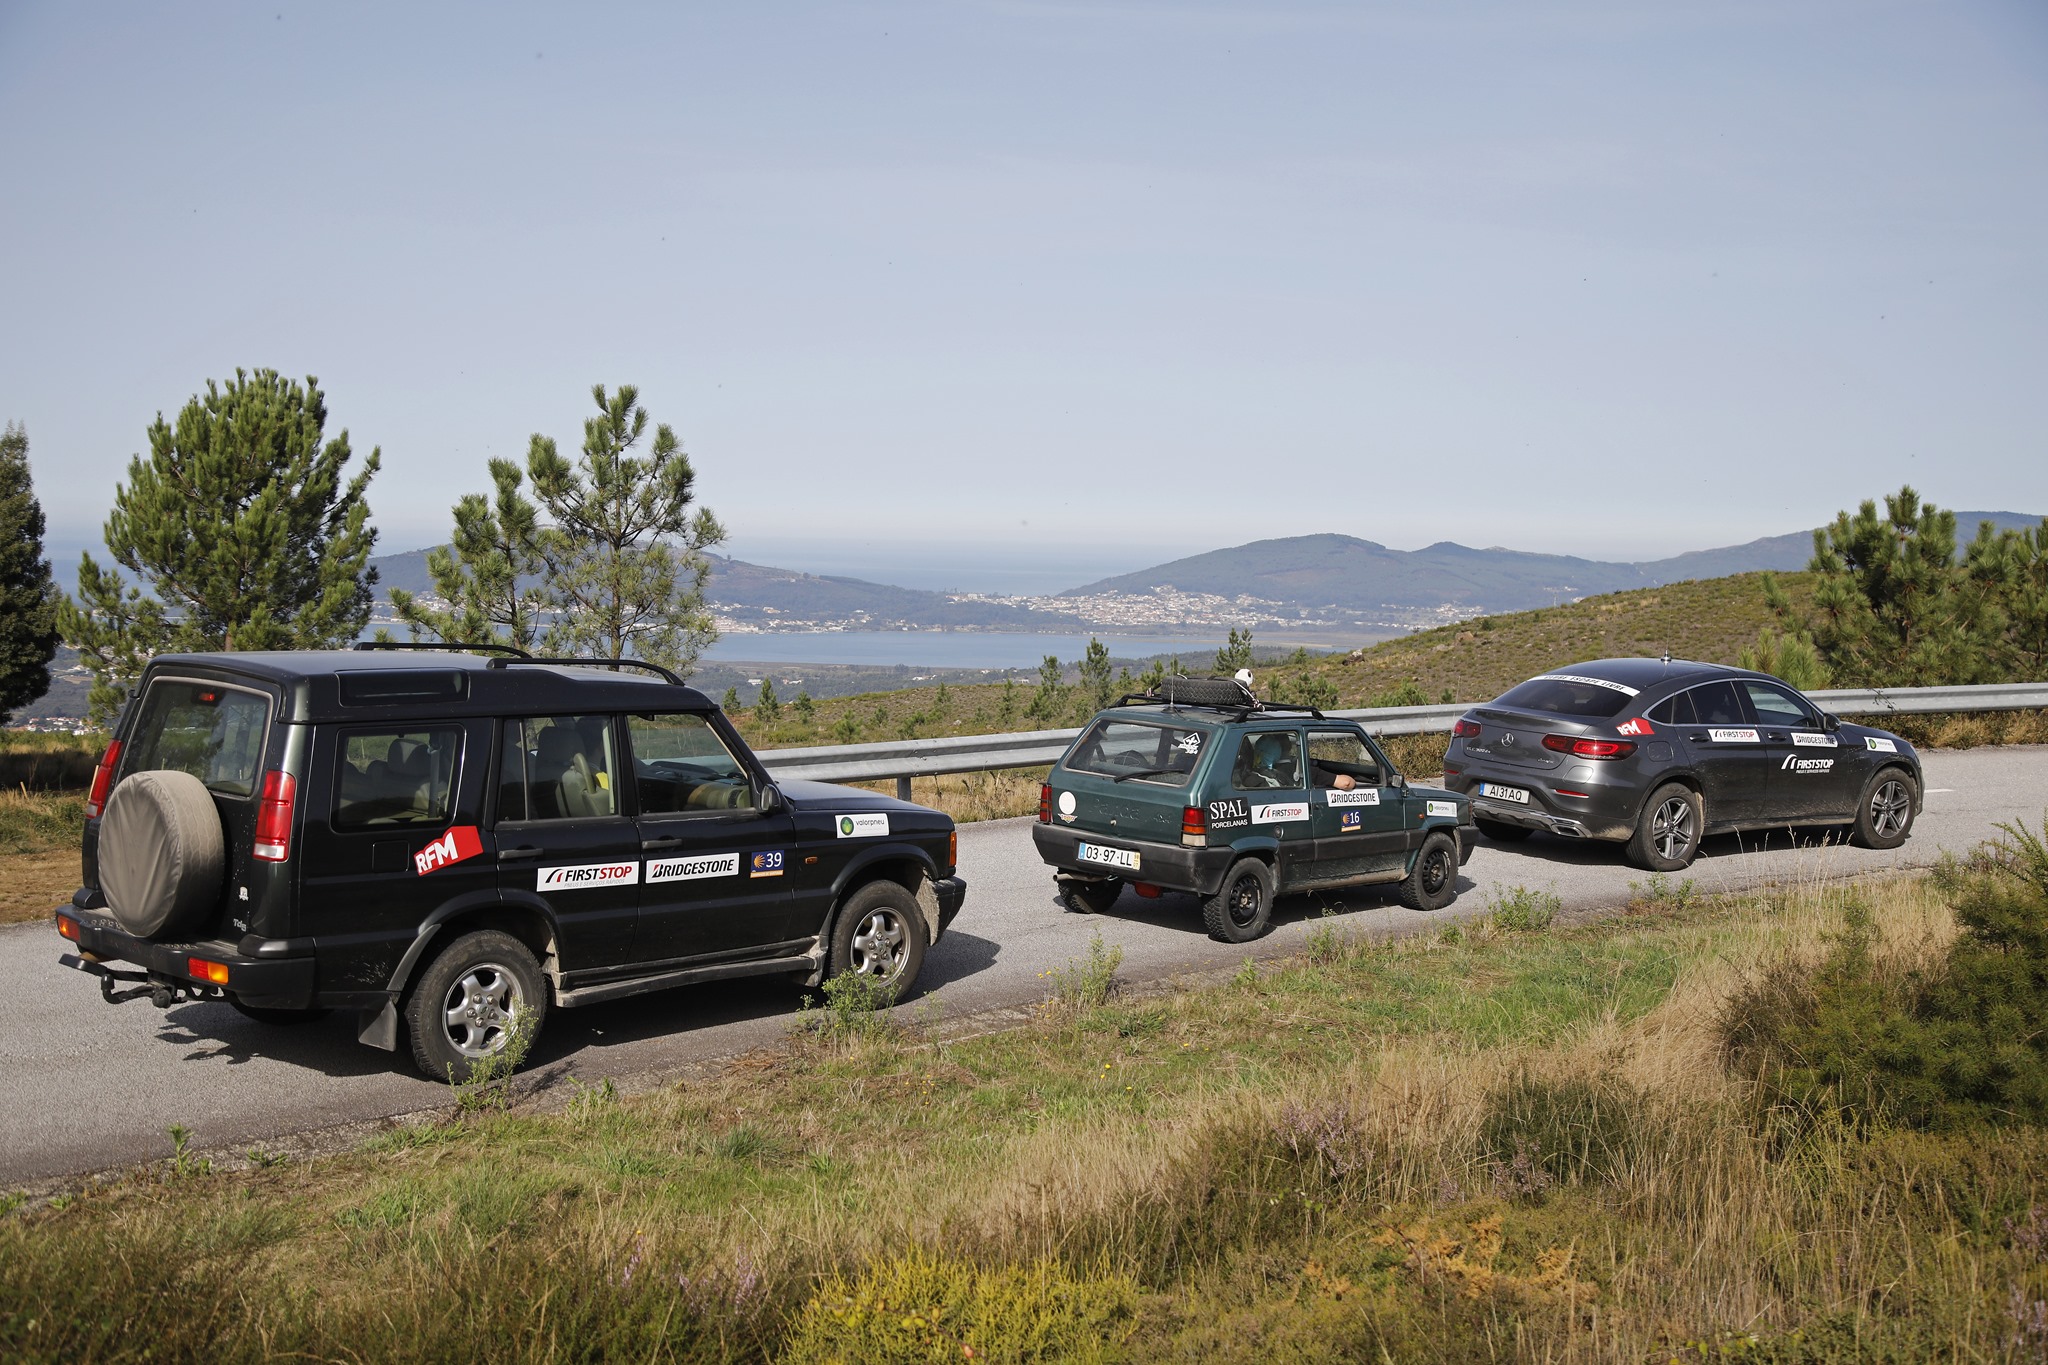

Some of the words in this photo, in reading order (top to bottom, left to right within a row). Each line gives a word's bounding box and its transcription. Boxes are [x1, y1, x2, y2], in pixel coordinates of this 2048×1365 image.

[1616, 720, 1642, 736] RFM
[1795, 735, 1836, 745] BRIDGESTONE
[1796, 759, 1835, 770] FIRSTSTOP
[1330, 792, 1376, 803] BRIDGESTONE
[1209, 799, 1248, 820] SPAL
[1271, 808, 1303, 818] FIRSTSTOP
[1211, 818, 1248, 829] PORCELANAS
[1350, 811, 1360, 824] 16
[415, 831, 459, 874] RFM
[765, 852, 782, 868] 39
[564, 866, 633, 882] FIRSTSTOP
[651, 859, 735, 878] BRIDGESTONE
